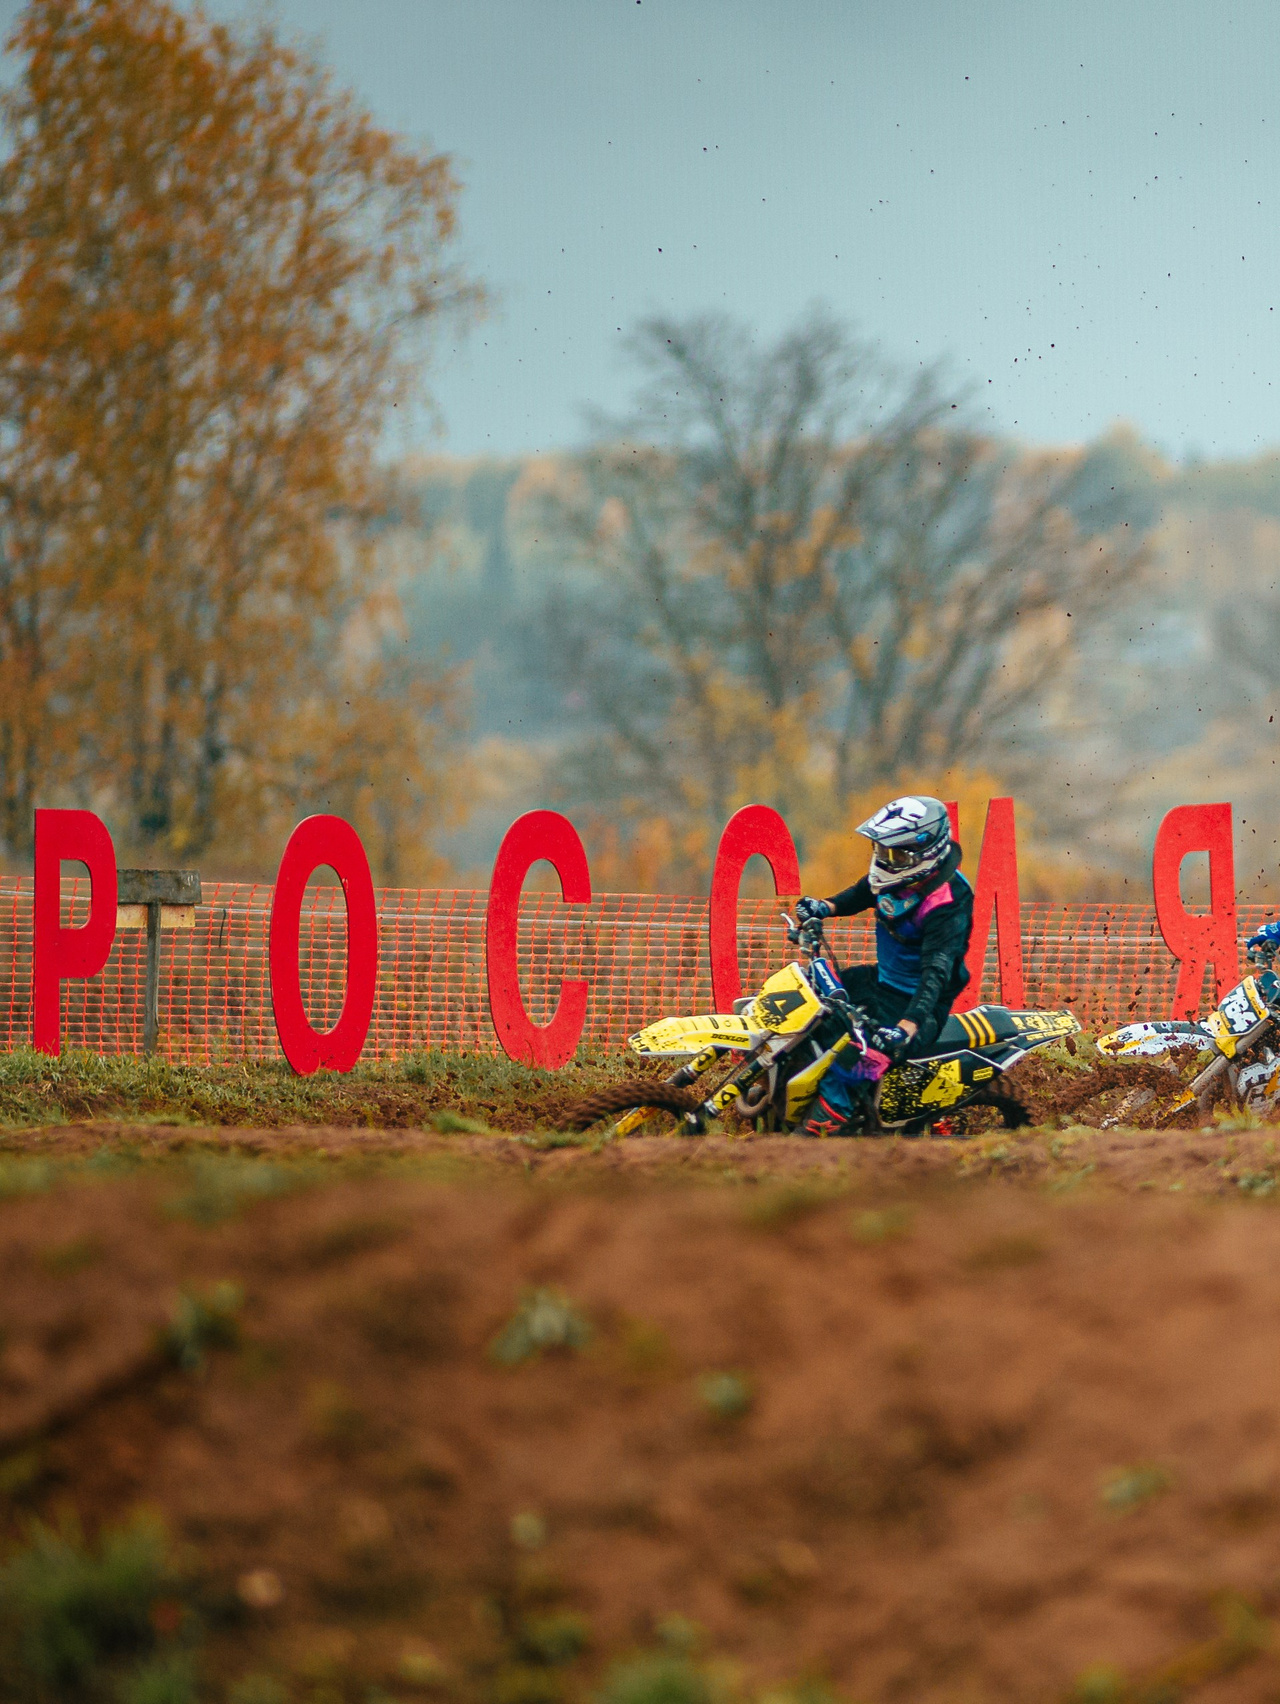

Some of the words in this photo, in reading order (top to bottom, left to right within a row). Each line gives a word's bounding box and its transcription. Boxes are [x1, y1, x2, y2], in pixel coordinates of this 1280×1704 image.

[763, 989, 808, 1029] 4
[709, 1032, 750, 1044] DUNLOP
[920, 1058, 965, 1109] 4
